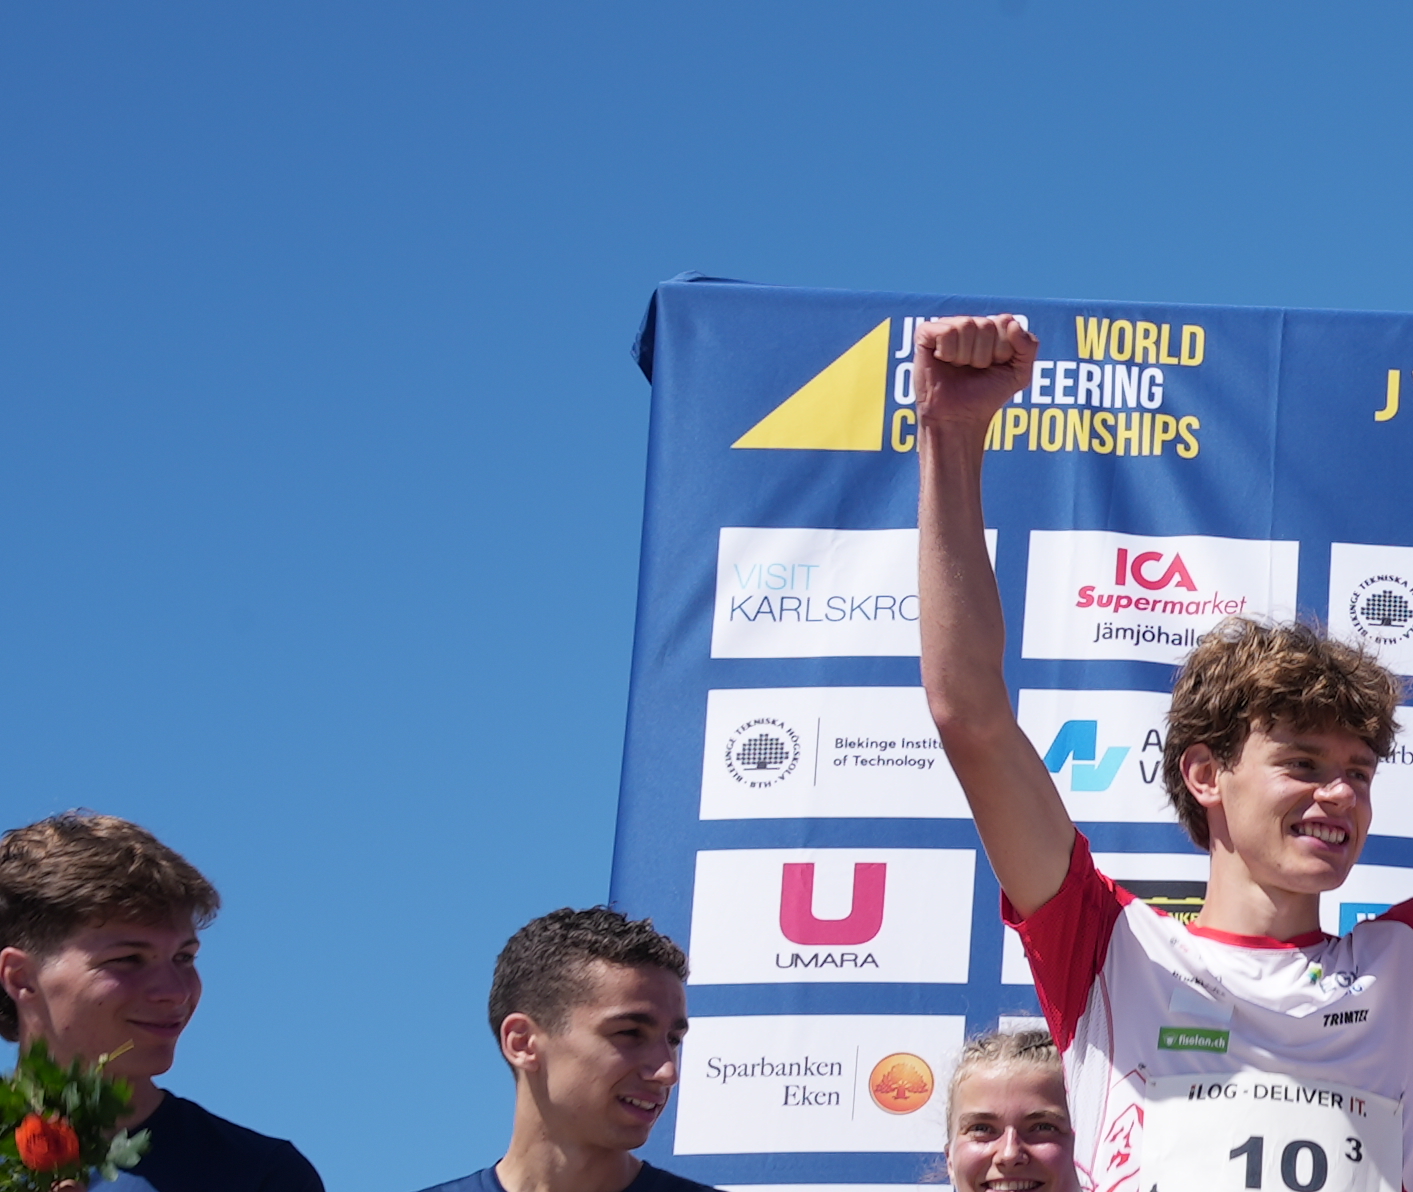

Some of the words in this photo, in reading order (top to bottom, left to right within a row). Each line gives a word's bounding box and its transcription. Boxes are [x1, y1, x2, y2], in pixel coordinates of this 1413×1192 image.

[1076, 316, 1205, 367] WORLD
[891, 409, 1201, 460] CMPIONSHIPS
[733, 564, 819, 591] VISIT
[1115, 547, 1198, 592] ICA
[730, 596, 919, 624] KARLSKRO
[1076, 585, 1248, 616] Supermarket
[1094, 622, 1201, 650] Jämjöhalle
[834, 737, 897, 751] Blekinge
[833, 755, 847, 767] of
[853, 755, 935, 770] Technology
[775, 952, 880, 969] UMARA
[705, 1055, 843, 1085] Sparbanken
[781, 1085, 841, 1107] Eken
[1253, 1083, 1343, 1111] DELIVER
[1349, 1096, 1368, 1118] IT.
[1345, 1136, 1364, 1163] 3
